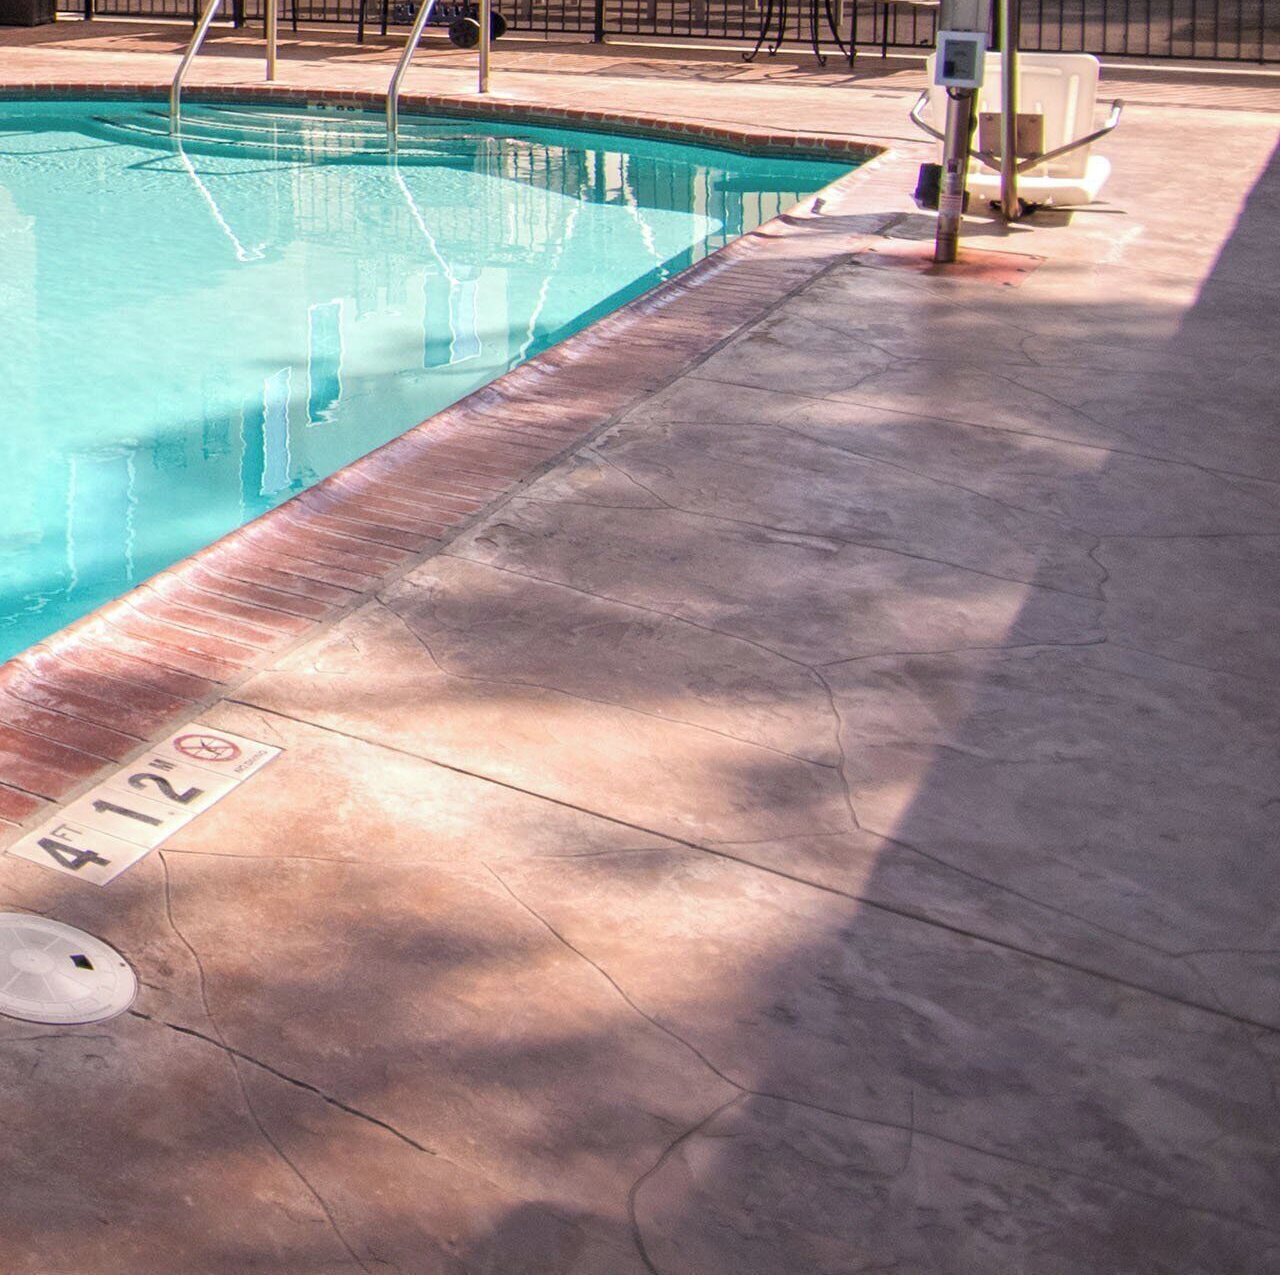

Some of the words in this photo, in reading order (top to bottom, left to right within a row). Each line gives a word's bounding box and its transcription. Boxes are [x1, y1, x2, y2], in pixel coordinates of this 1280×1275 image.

[147, 758, 180, 772] M
[52, 823, 86, 843] FT
[37, 835, 112, 872] 4
